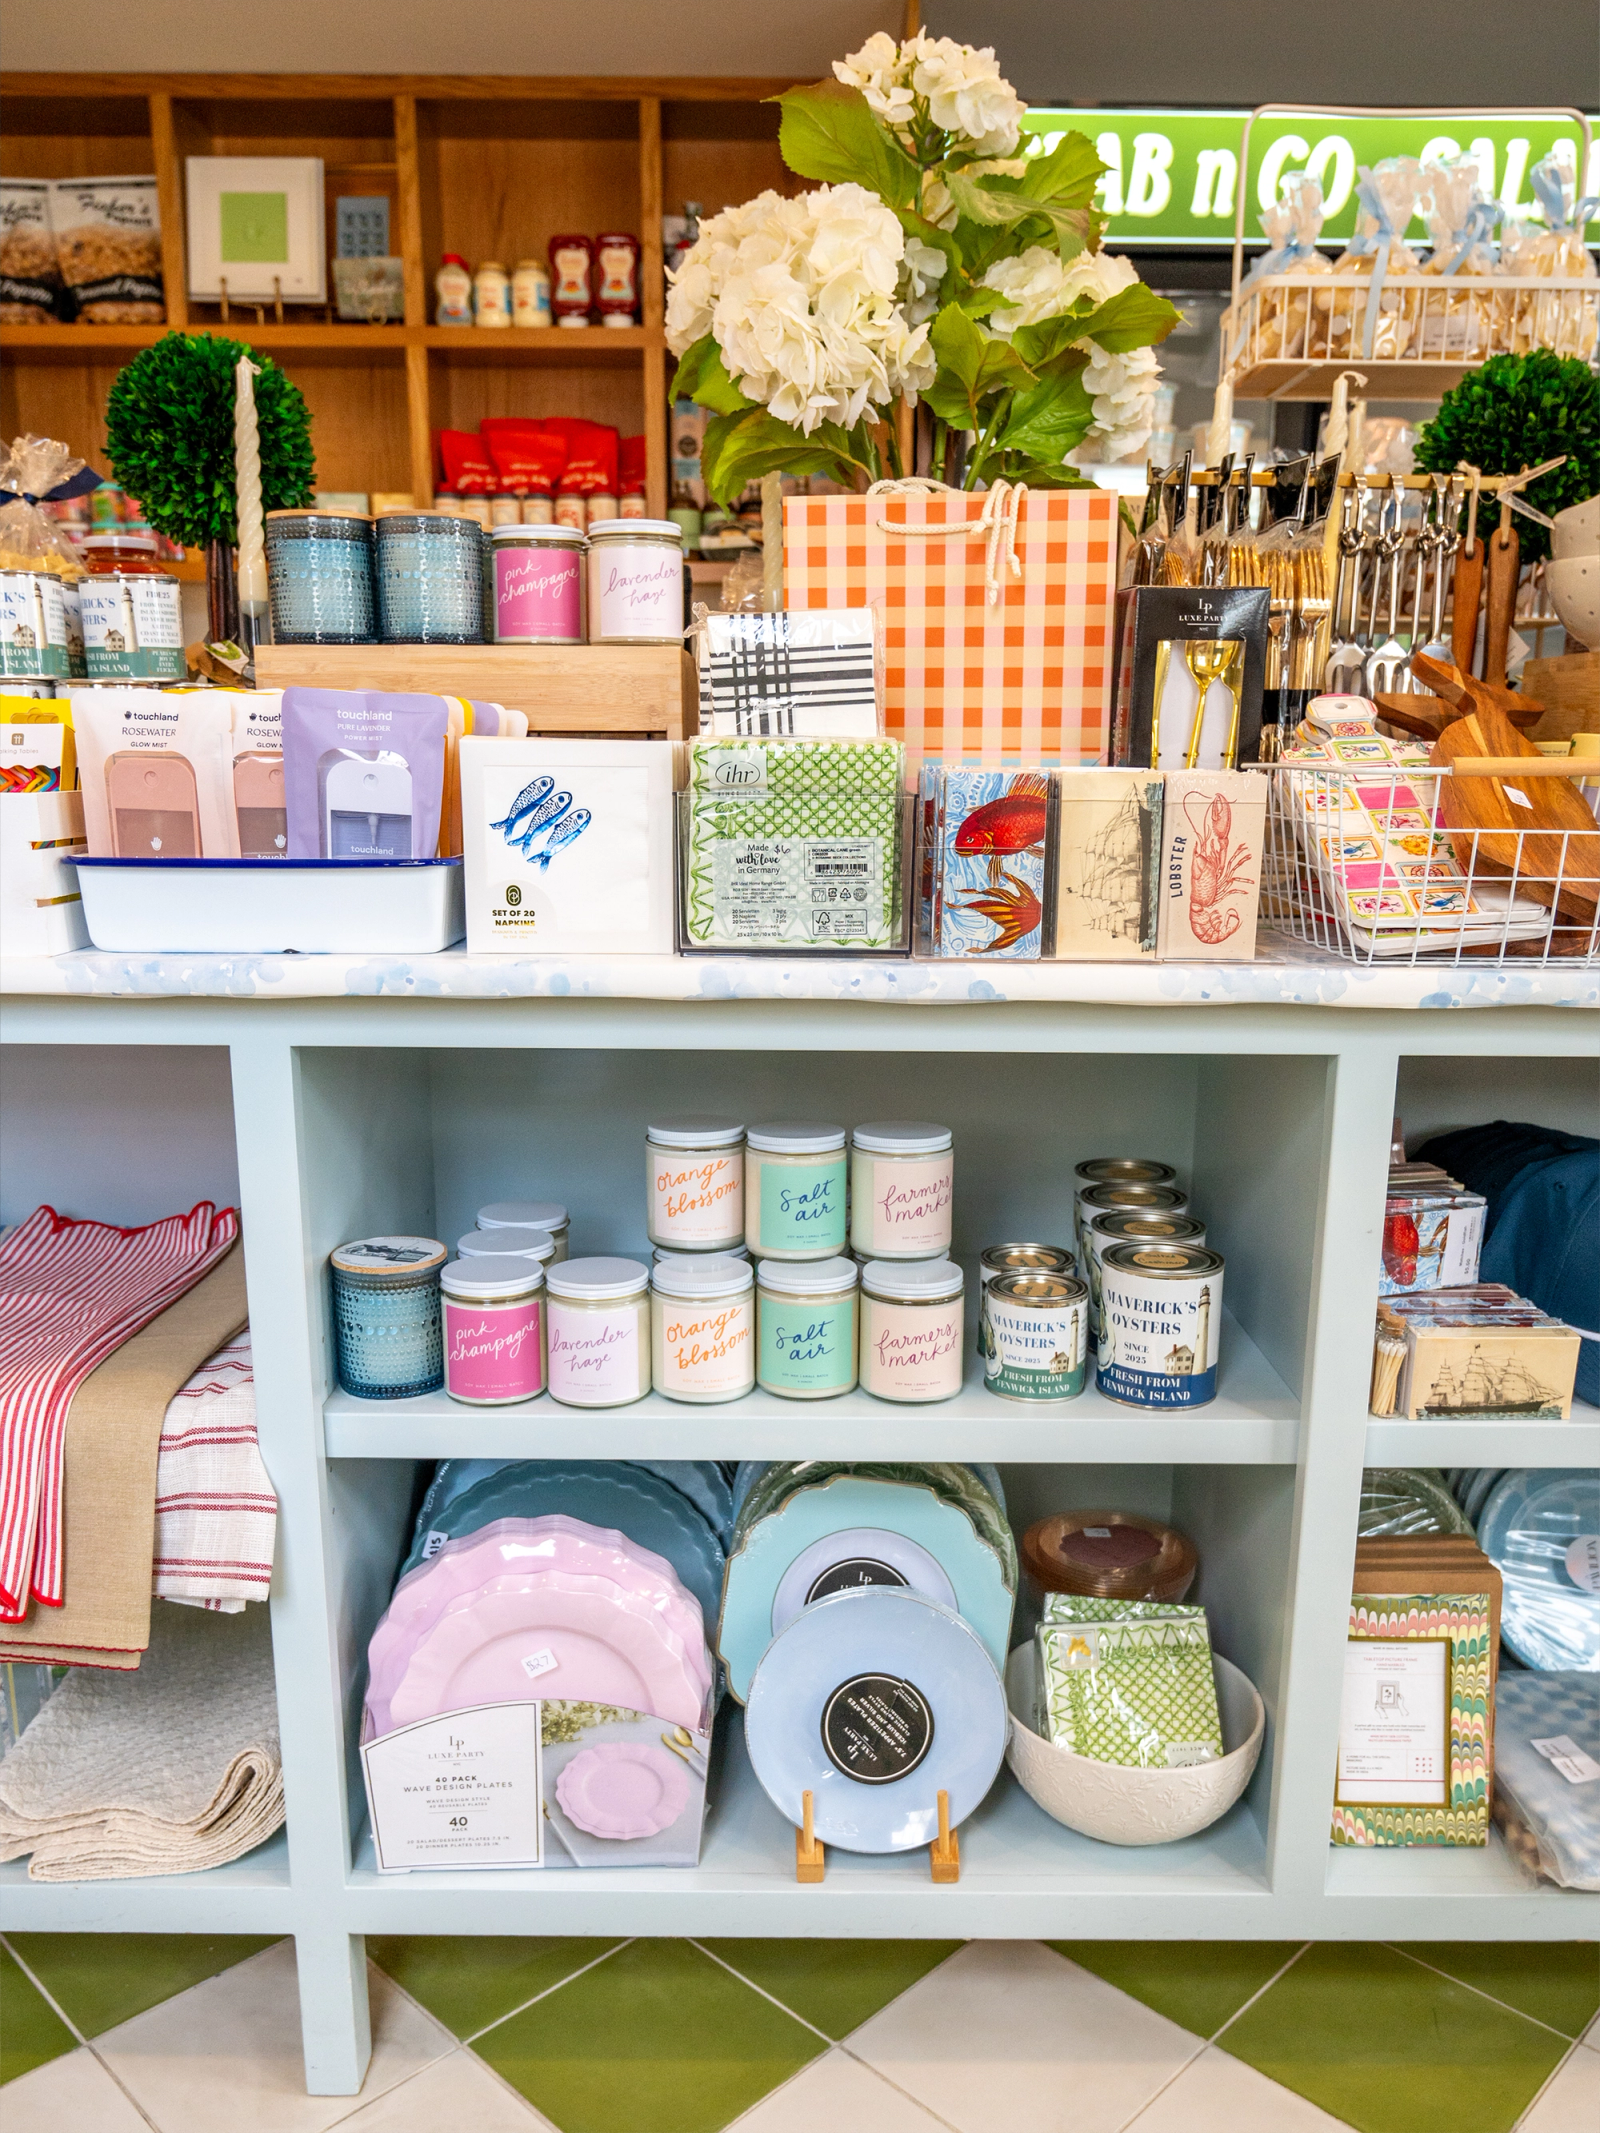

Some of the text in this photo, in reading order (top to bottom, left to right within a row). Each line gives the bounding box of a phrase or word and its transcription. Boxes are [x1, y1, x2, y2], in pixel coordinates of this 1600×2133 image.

[1095, 132, 1174, 217] AB
[1190, 148, 1237, 217] n
[505, 559, 541, 590] pink
[603, 561, 680, 597] lavender
[498, 568, 579, 605] champagne
[622, 589, 667, 607] haze
[99, 664, 130, 673] ISLAND
[134, 712, 179, 722] touchland
[258, 712, 282, 722] touch
[336, 709, 393, 721] touchland
[121, 727, 176, 737] ROSEWATER
[246, 727, 282, 737] ROSEW
[337, 723, 391, 732] PURE LAVENDER
[726, 764, 754, 783] ihr
[350, 844, 394, 856] touchland
[747, 844, 769, 852] Made
[774, 844, 791, 855] $6
[736, 852, 781, 866] with love
[1169, 836, 1187, 898] LOBSTER
[746, 866, 780, 876] Germany
[492, 909, 507, 917] SET
[509, 909, 521, 917] OF
[657, 1159, 730, 1192] orange
[663, 1179, 741, 1218] blossom
[780, 1178, 836, 1212] Salt
[795, 1203, 836, 1221] air
[895, 1193, 951, 1223] marke
[1106, 1289, 1197, 1315] MAVERICK'S
[667, 1307, 743, 1343] orange
[994, 1313, 1066, 1332] MAVERICK'S
[1112, 1312, 1181, 1335] OYSTERS
[450, 1320, 539, 1361] champagne
[456, 1320, 497, 1349] pink
[551, 1326, 633, 1353] lavender
[776, 1320, 835, 1349] Salt
[999, 1332, 1056, 1348] OYSTERS
[673, 1326, 751, 1369] blossom
[789, 1343, 835, 1360] air
[889, 1329, 959, 1368] market
[1123, 1341, 1149, 1353] SINCE
[564, 1353, 612, 1372] haze
[1124, 1353, 1147, 1364] 2025
[1004, 1370, 1062, 1383] FRESH FROM
[1110, 1367, 1180, 1388] FRESH FROM
[996, 1379, 1069, 1394] FENWICK ISLAND
[1103, 1376, 1191, 1401] FENWICK ISLAND
[525, 1655, 550, 1672] $27
[847, 1697, 868, 1718] PLATES
[859, 1697, 877, 1715] SILVER
[875, 1713, 888, 1724] AND
[866, 1717, 896, 1746] APPETIZER
[885, 1723, 907, 1745] ICEBLUE
[844, 1725, 878, 1762] LUXE PARTY
[428, 1752, 453, 1760] LUXE
[403, 1781, 513, 1793] WAVE DESIGN PLATES
[449, 1817, 468, 1827] 40
